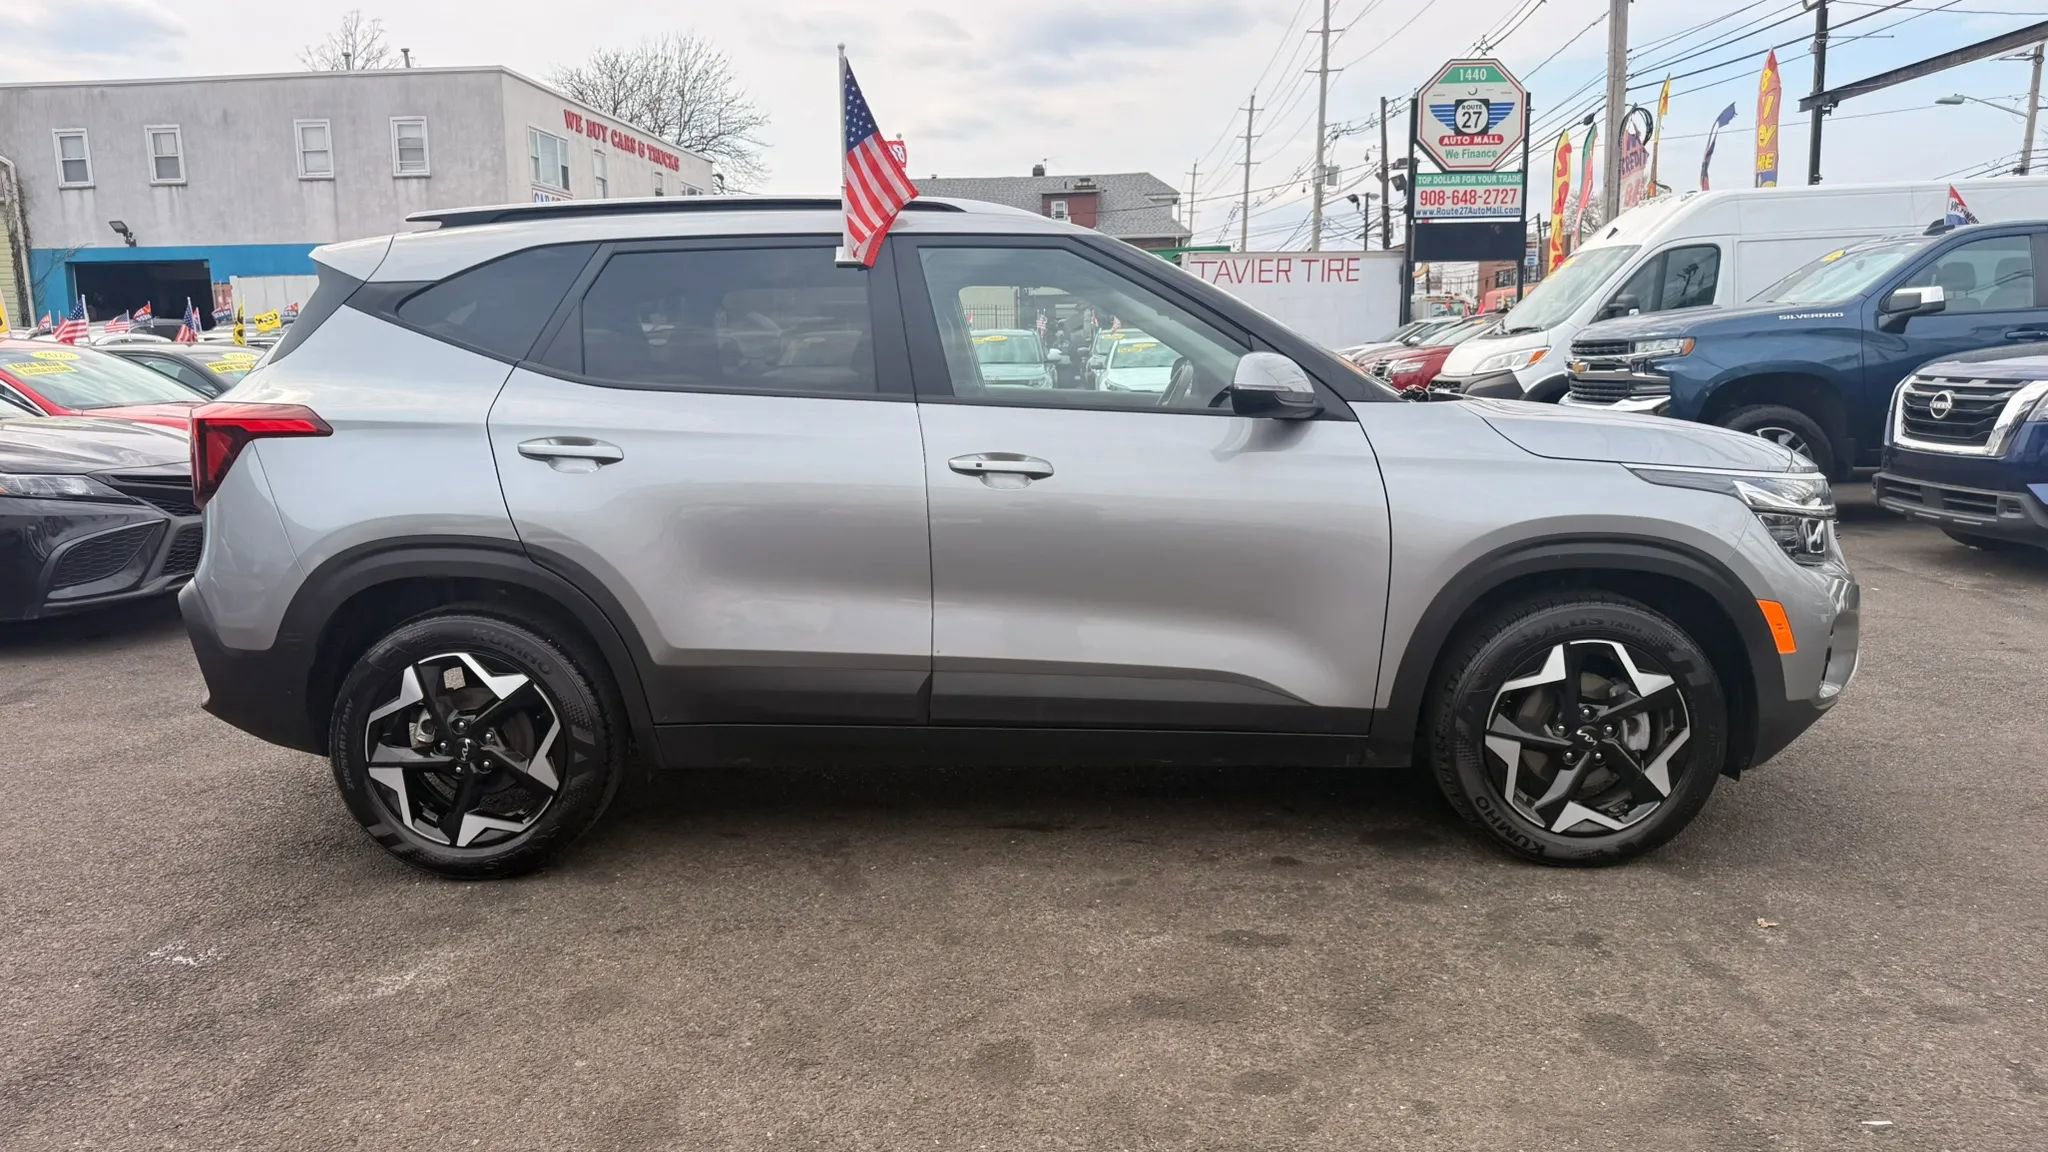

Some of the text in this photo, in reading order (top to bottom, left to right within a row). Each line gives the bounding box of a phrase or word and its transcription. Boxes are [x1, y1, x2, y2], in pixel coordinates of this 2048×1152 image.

[1459, 68, 1487, 81] 1440
[1461, 111, 1483, 129] 27
[563, 109, 680, 172] WE BUY CARS & TRUCKS
[1442, 135, 1501, 145] AUTO MALL
[1445, 148, 1498, 159] We Finance
[1418, 174, 1521, 184] TOP DOLLAR FOR YOUR TRADE
[1420, 188, 1518, 206] 908-648-2727
[1416, 206, 1521, 216] www.Route27AutoMall.com
[1190, 257, 1361, 285] TAVIER TIRE
[1778, 312, 1844, 320] SILVERADO
[1475, 795, 1545, 860] KUMHO
